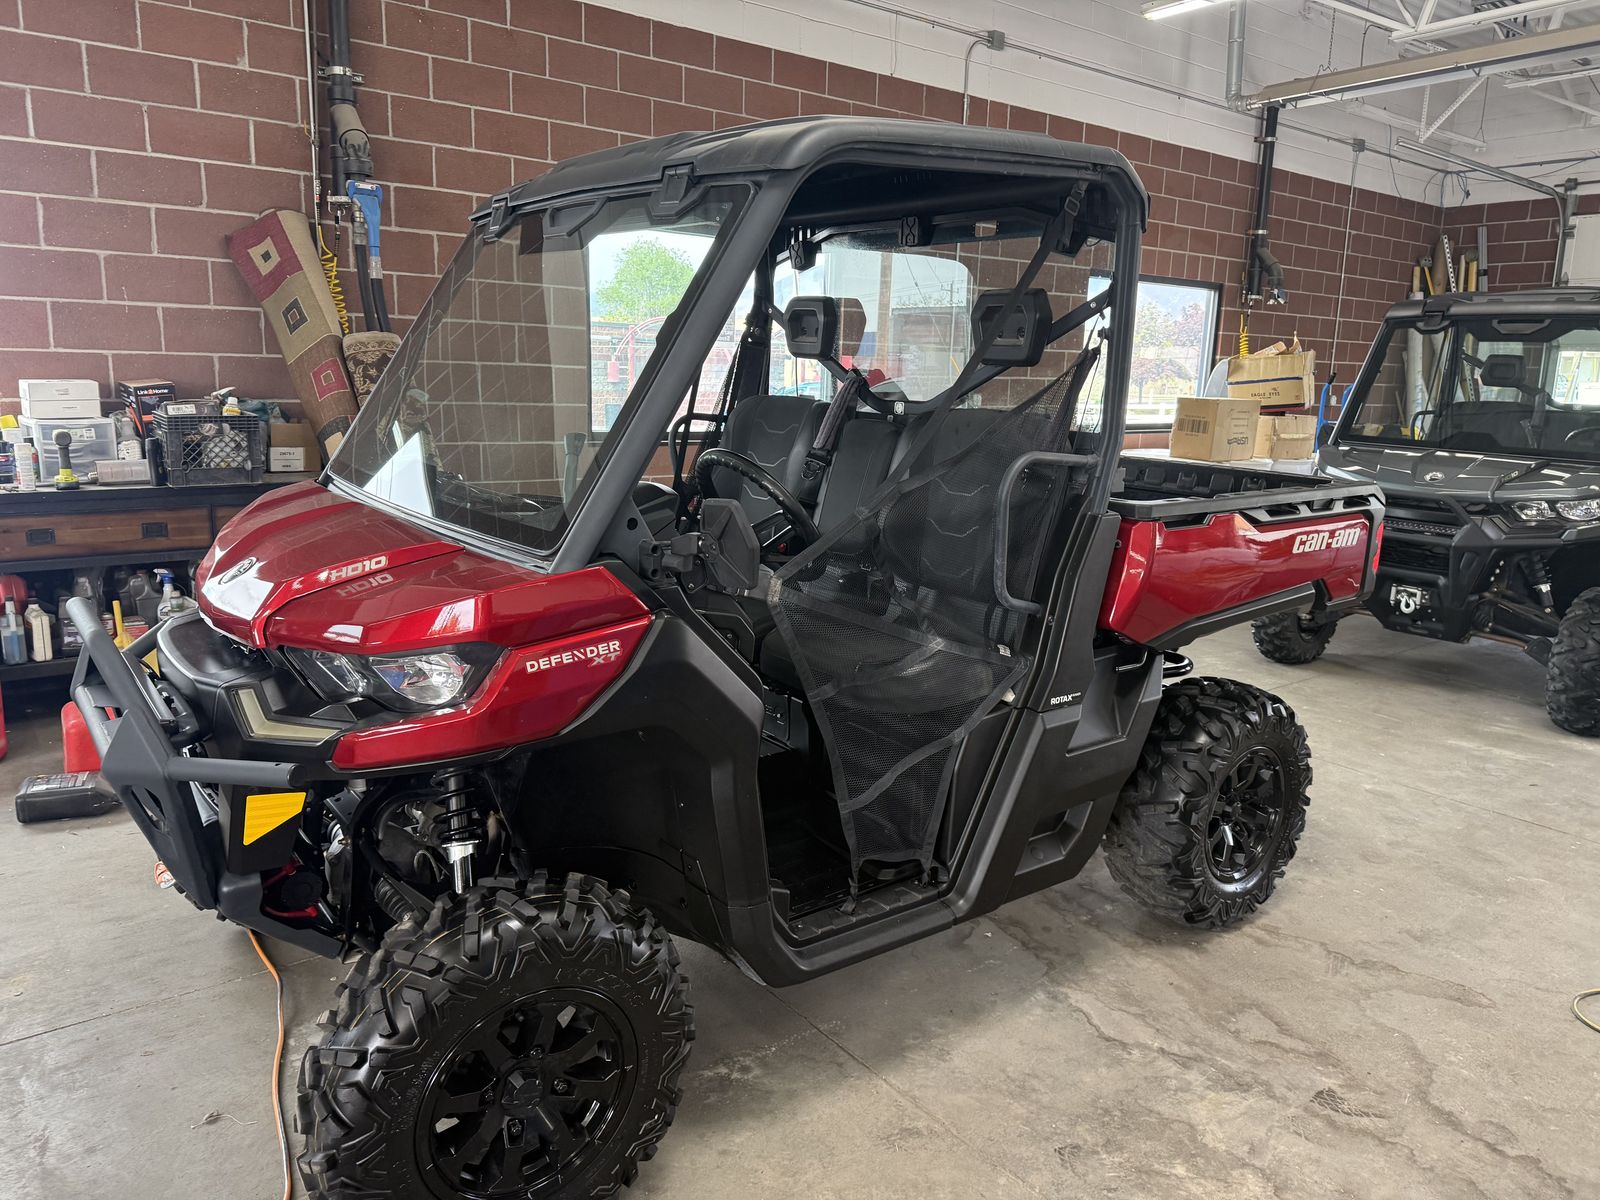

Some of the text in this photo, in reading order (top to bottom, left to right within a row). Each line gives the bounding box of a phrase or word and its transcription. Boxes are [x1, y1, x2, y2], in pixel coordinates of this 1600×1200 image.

[330, 555, 388, 582] HD10
[525, 640, 621, 673] DEFENDER
[588, 651, 621, 667] XT
[1050, 694, 1073, 705] ROTAX
